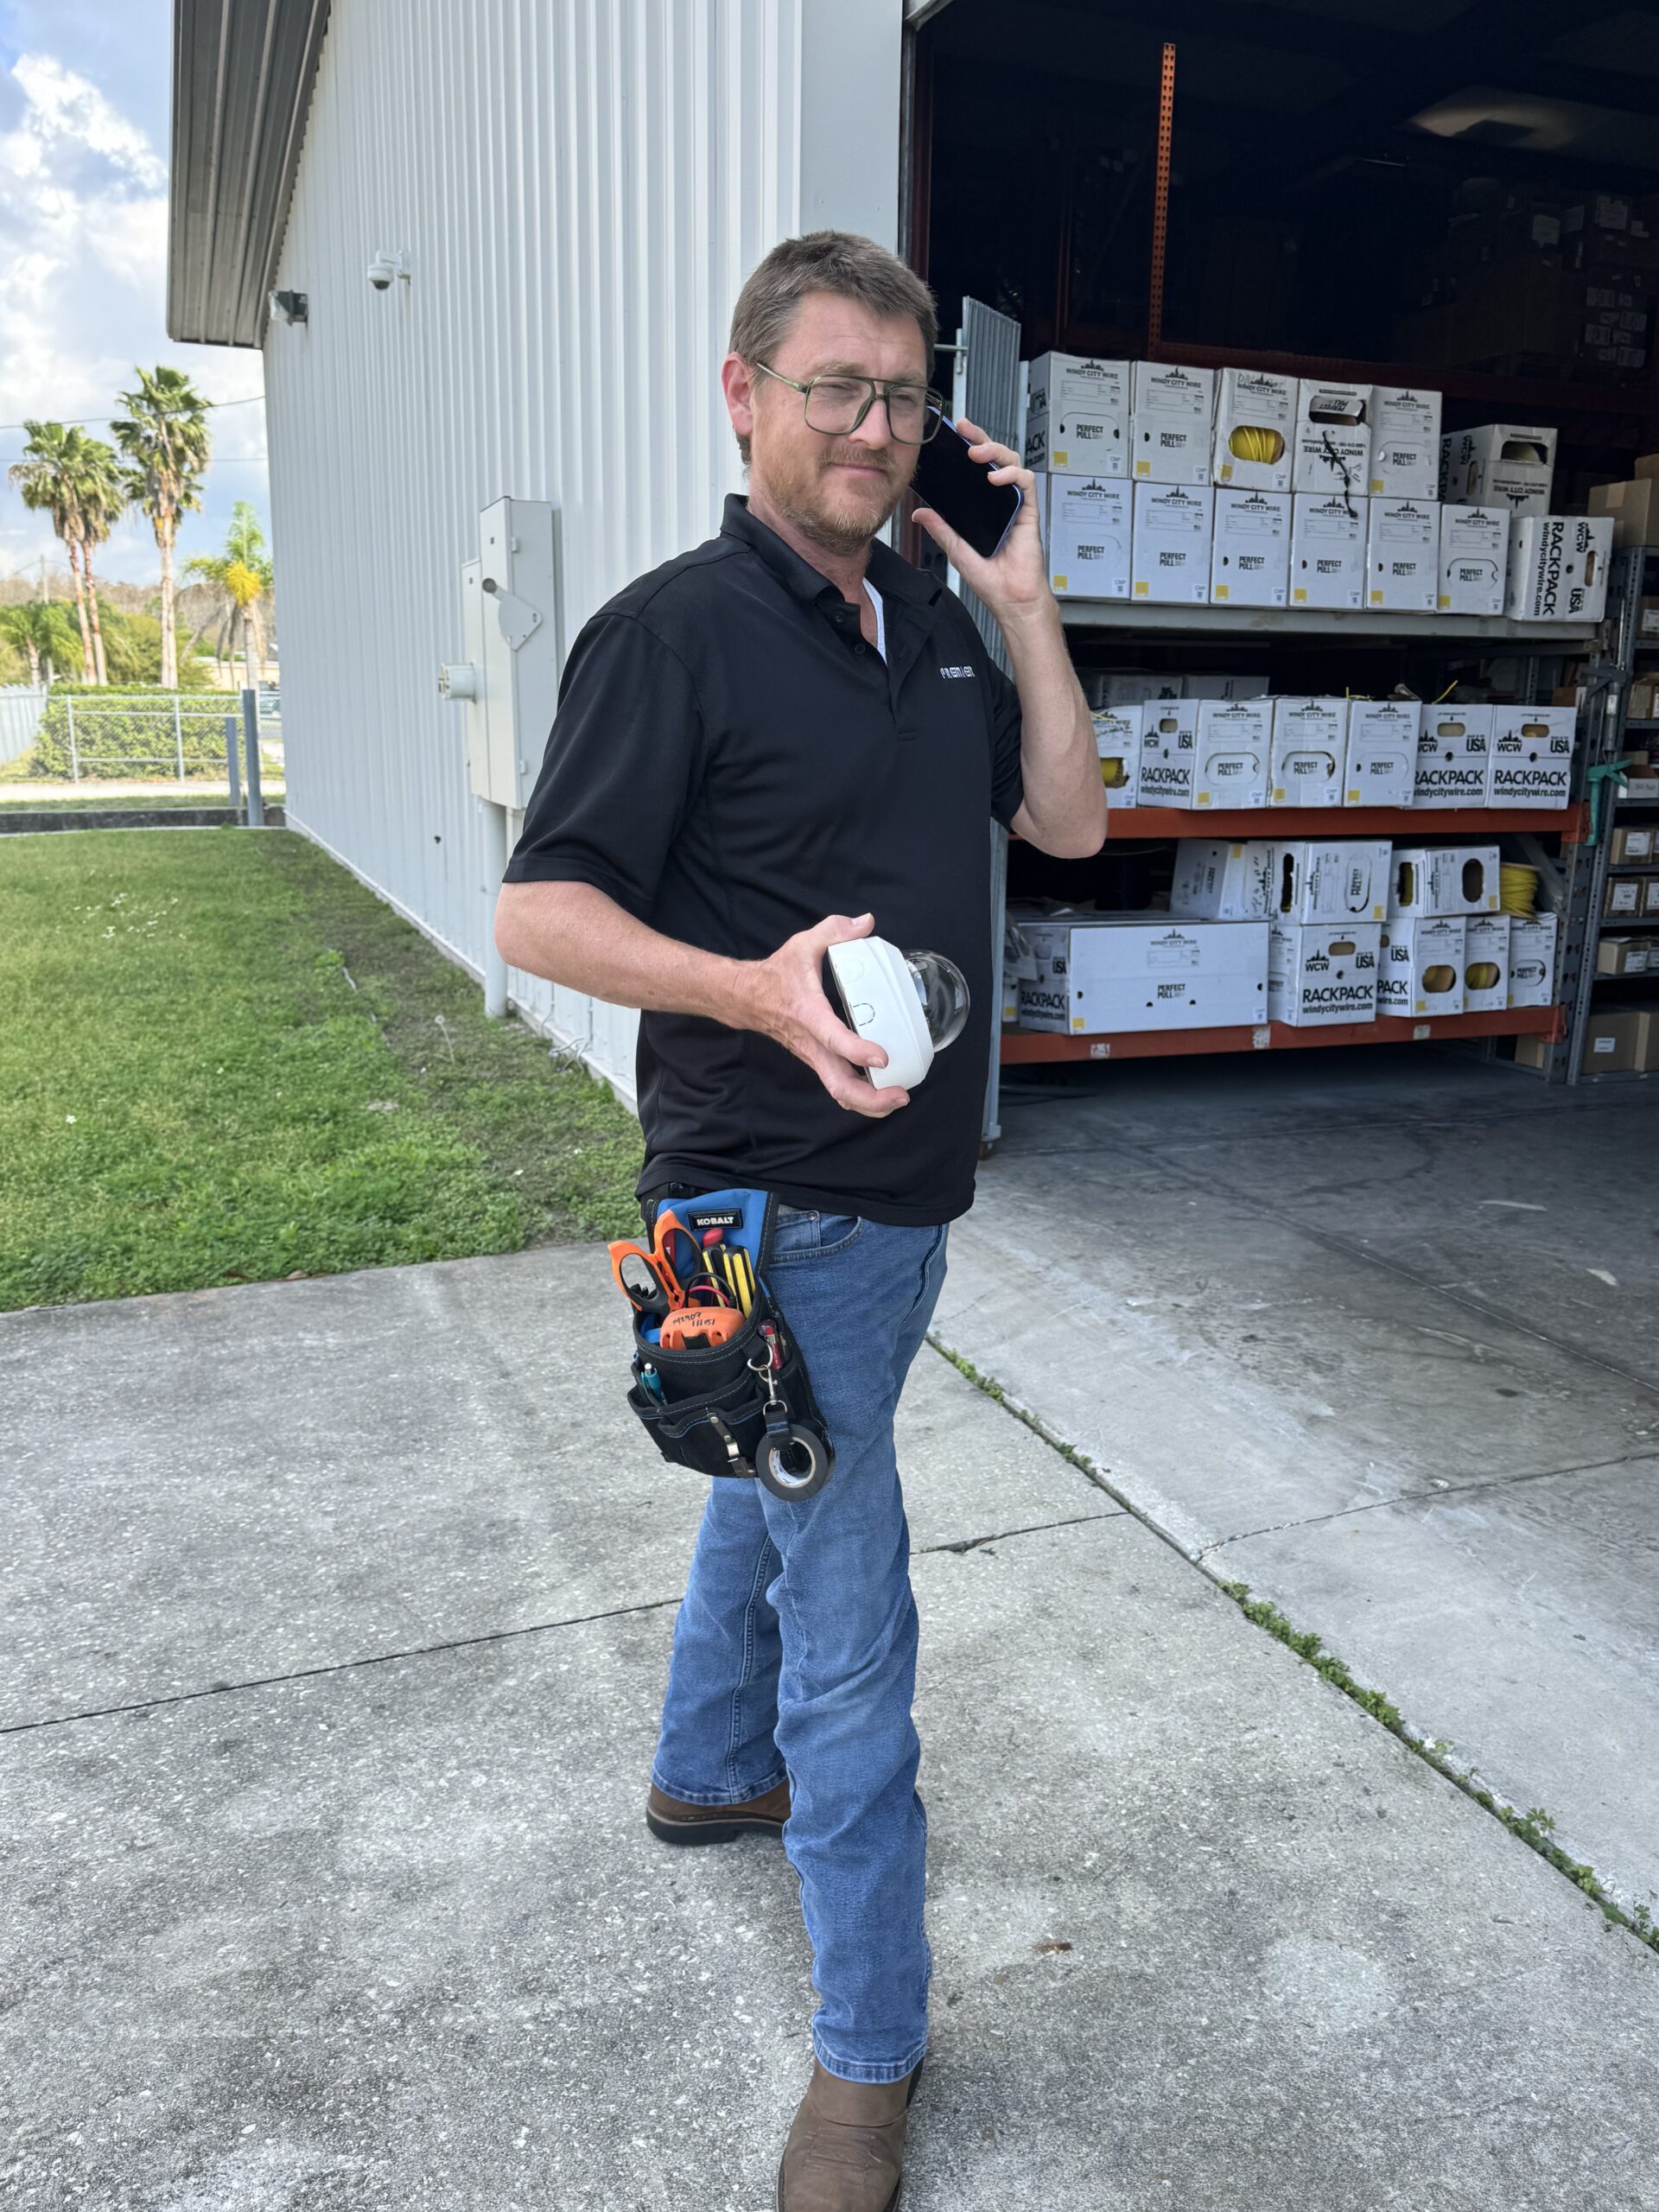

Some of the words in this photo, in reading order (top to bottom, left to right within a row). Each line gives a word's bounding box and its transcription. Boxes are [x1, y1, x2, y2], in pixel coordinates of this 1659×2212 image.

[1066, 367, 1086, 377] WINDY
[1077, 424, 1103, 434] PERFECT
[1077, 431, 1092, 440] PULL
[1160, 433, 1187, 442] PERFECT
[1393, 452, 1416, 461] PERFECT
[1576, 522, 1586, 553] WCW
[1077, 545, 1105, 554] PERFECT
[1160, 552, 1186, 561] PERFECT
[1239, 556, 1265, 564] PERFECT
[1534, 522, 1550, 616] windycitywire.com
[1542, 522, 1564, 615] RACKPACK
[1568, 588, 1582, 613] USA
[1179, 734, 1193, 749] USA
[1466, 739, 1486, 752] USA
[1497, 743, 1522, 753] WCW
[1550, 740, 1570, 753] USA
[1141, 766, 1191, 785] RACKPACK
[1494, 770, 1567, 786] RACKPACK
[1494, 787, 1567, 798] windycitywire.com
[1391, 949, 1409, 962] USA
[1052, 960, 1067, 975] USA
[1306, 963, 1330, 971] WCW
[1356, 955, 1375, 969] USA
[1158, 983, 1185, 993] PERFECT
[1303, 985, 1373, 1003] RACKPACK
[1377, 981, 1408, 995] PACK
[1020, 991, 1065, 1010] RACKPACK
[1302, 1001, 1373, 1015] windycitywire.com
[696, 1217, 734, 1226] KOBALT
